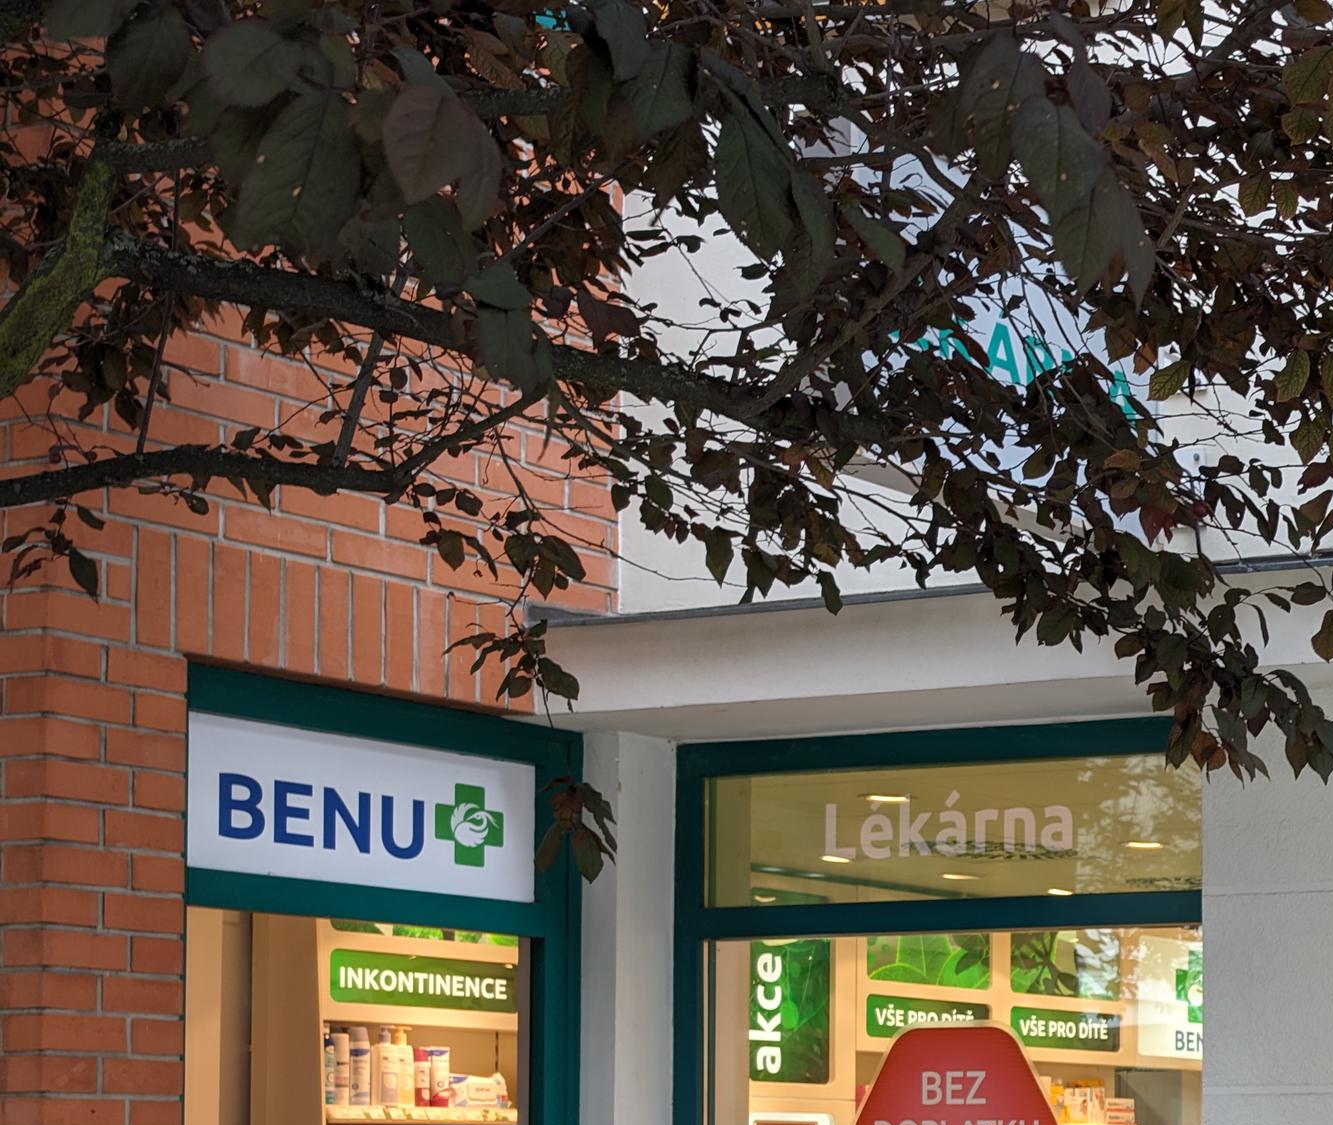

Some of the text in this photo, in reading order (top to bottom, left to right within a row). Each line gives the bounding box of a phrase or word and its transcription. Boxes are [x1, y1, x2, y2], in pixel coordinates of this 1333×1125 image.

[218, 772, 425, 860] BENU
[824, 790, 1074, 861] Lékárna
[338, 965, 508, 1001] INKONTINENCE
[748, 951, 783, 1074] akce
[876, 1003, 905, 1027] VŠE
[1019, 1017, 1110, 1041] VŠE PRO DÍTĚ
[921, 1071, 987, 1105] BEZ
